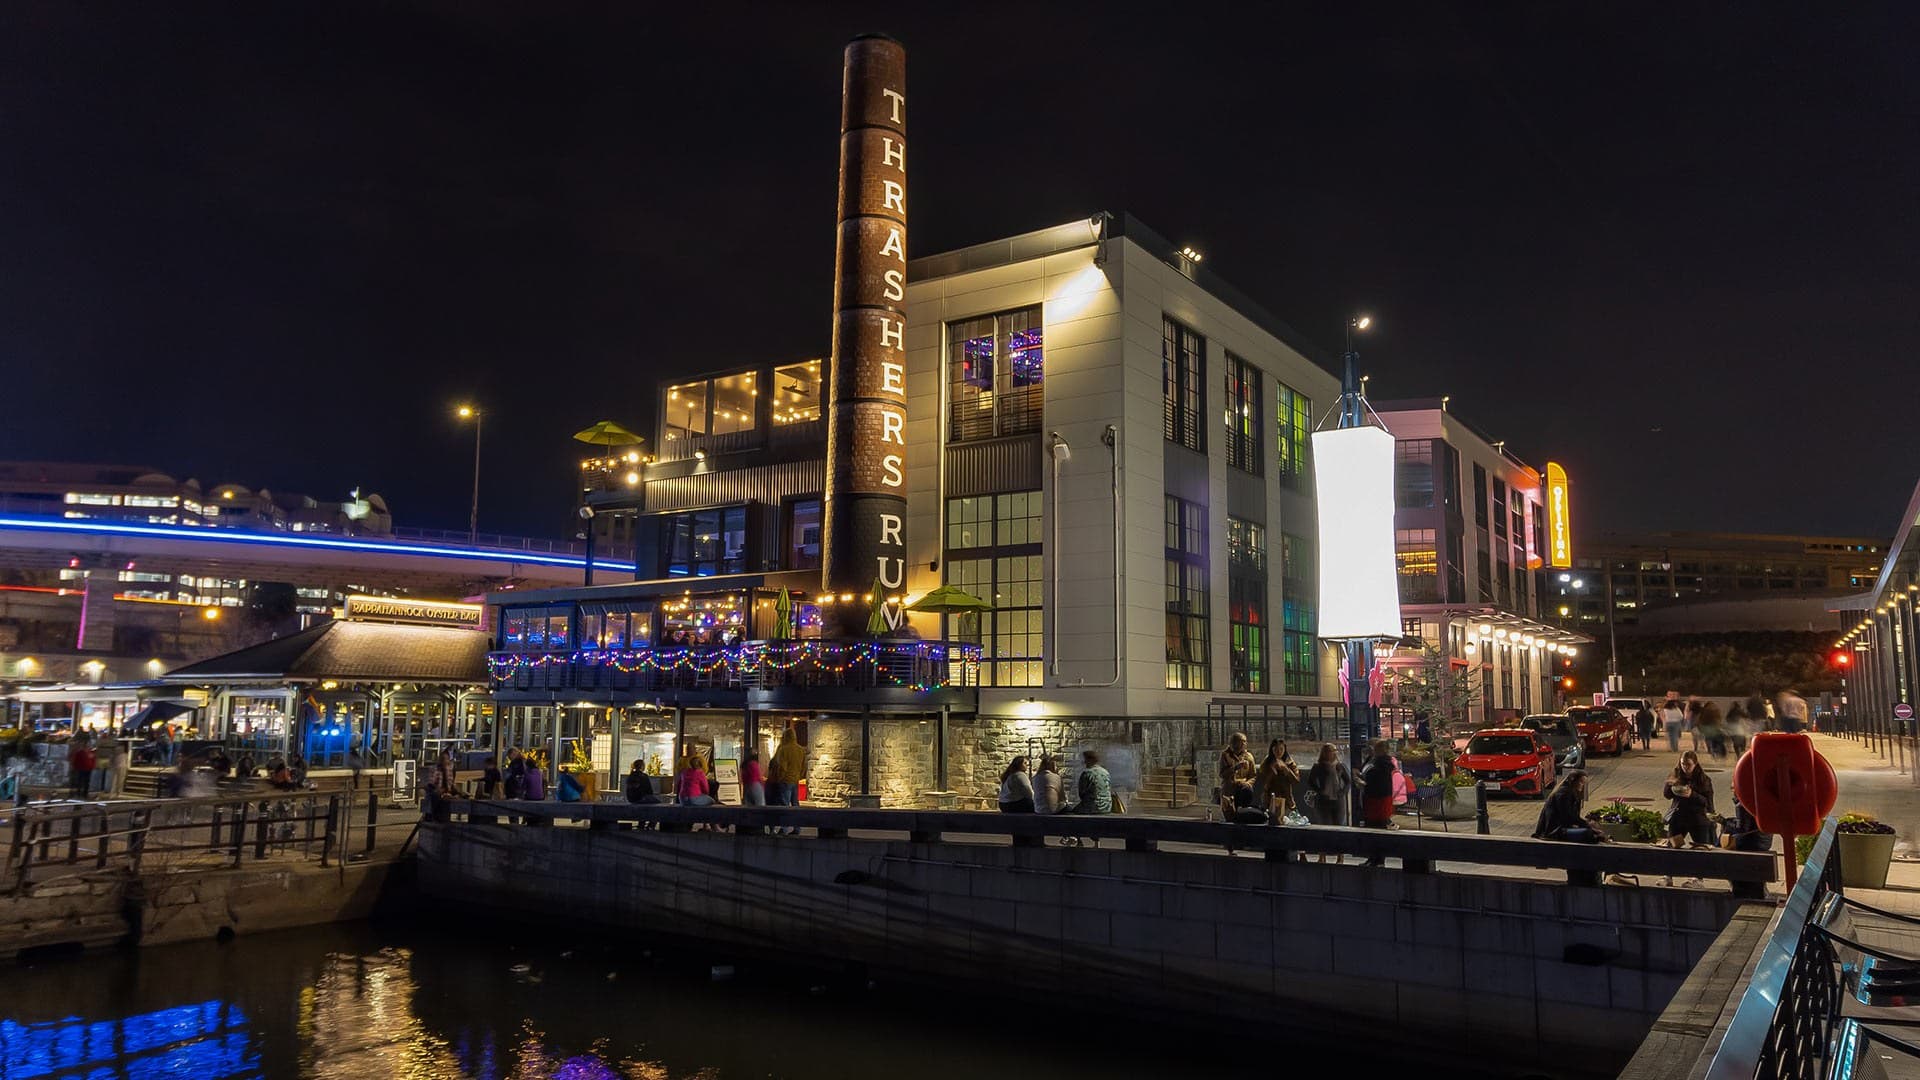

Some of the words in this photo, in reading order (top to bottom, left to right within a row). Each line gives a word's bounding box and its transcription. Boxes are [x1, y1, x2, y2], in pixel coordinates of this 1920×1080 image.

[879, 87, 905, 488] THRASHERS
[352, 602, 425, 617] RAPPAHANNOCK
[426, 607, 458, 620] OYSTER
[460, 611, 477, 621] BAR
[877, 514, 905, 631] RUM
